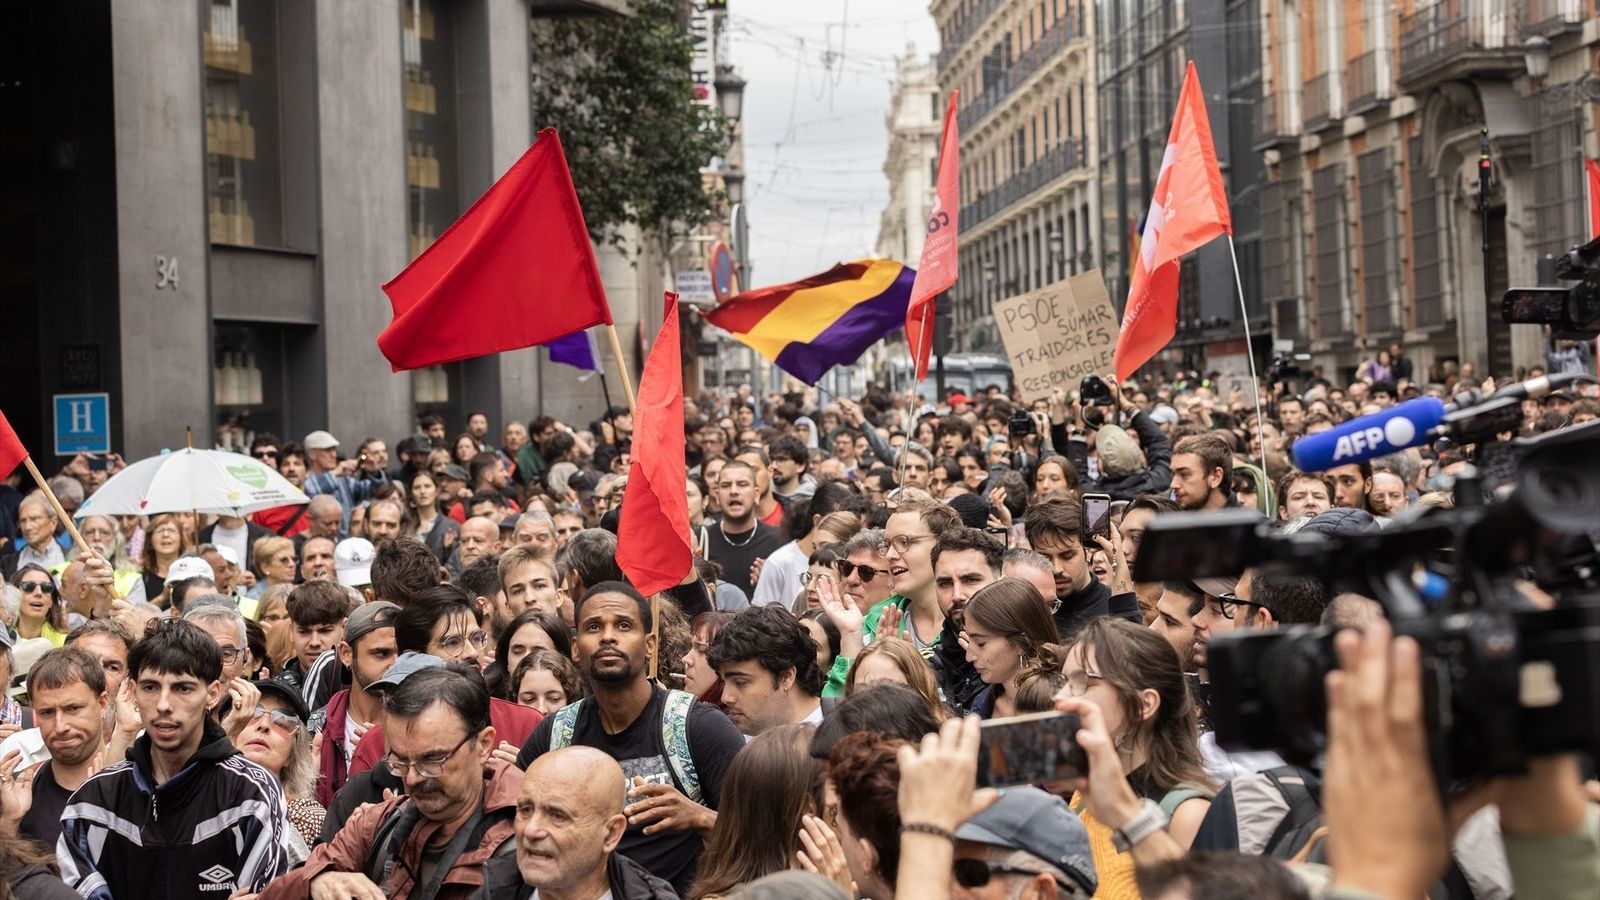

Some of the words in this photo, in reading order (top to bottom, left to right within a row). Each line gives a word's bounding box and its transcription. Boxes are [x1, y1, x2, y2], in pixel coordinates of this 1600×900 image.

[156, 255, 180, 291] 34
[1003, 294, 1060, 332] PSOE
[1057, 304, 1111, 336] SUMAR
[1015, 327, 1111, 368] TRAIDORES
[70, 401, 94, 433] H
[1332, 427, 1385, 461] AFP
